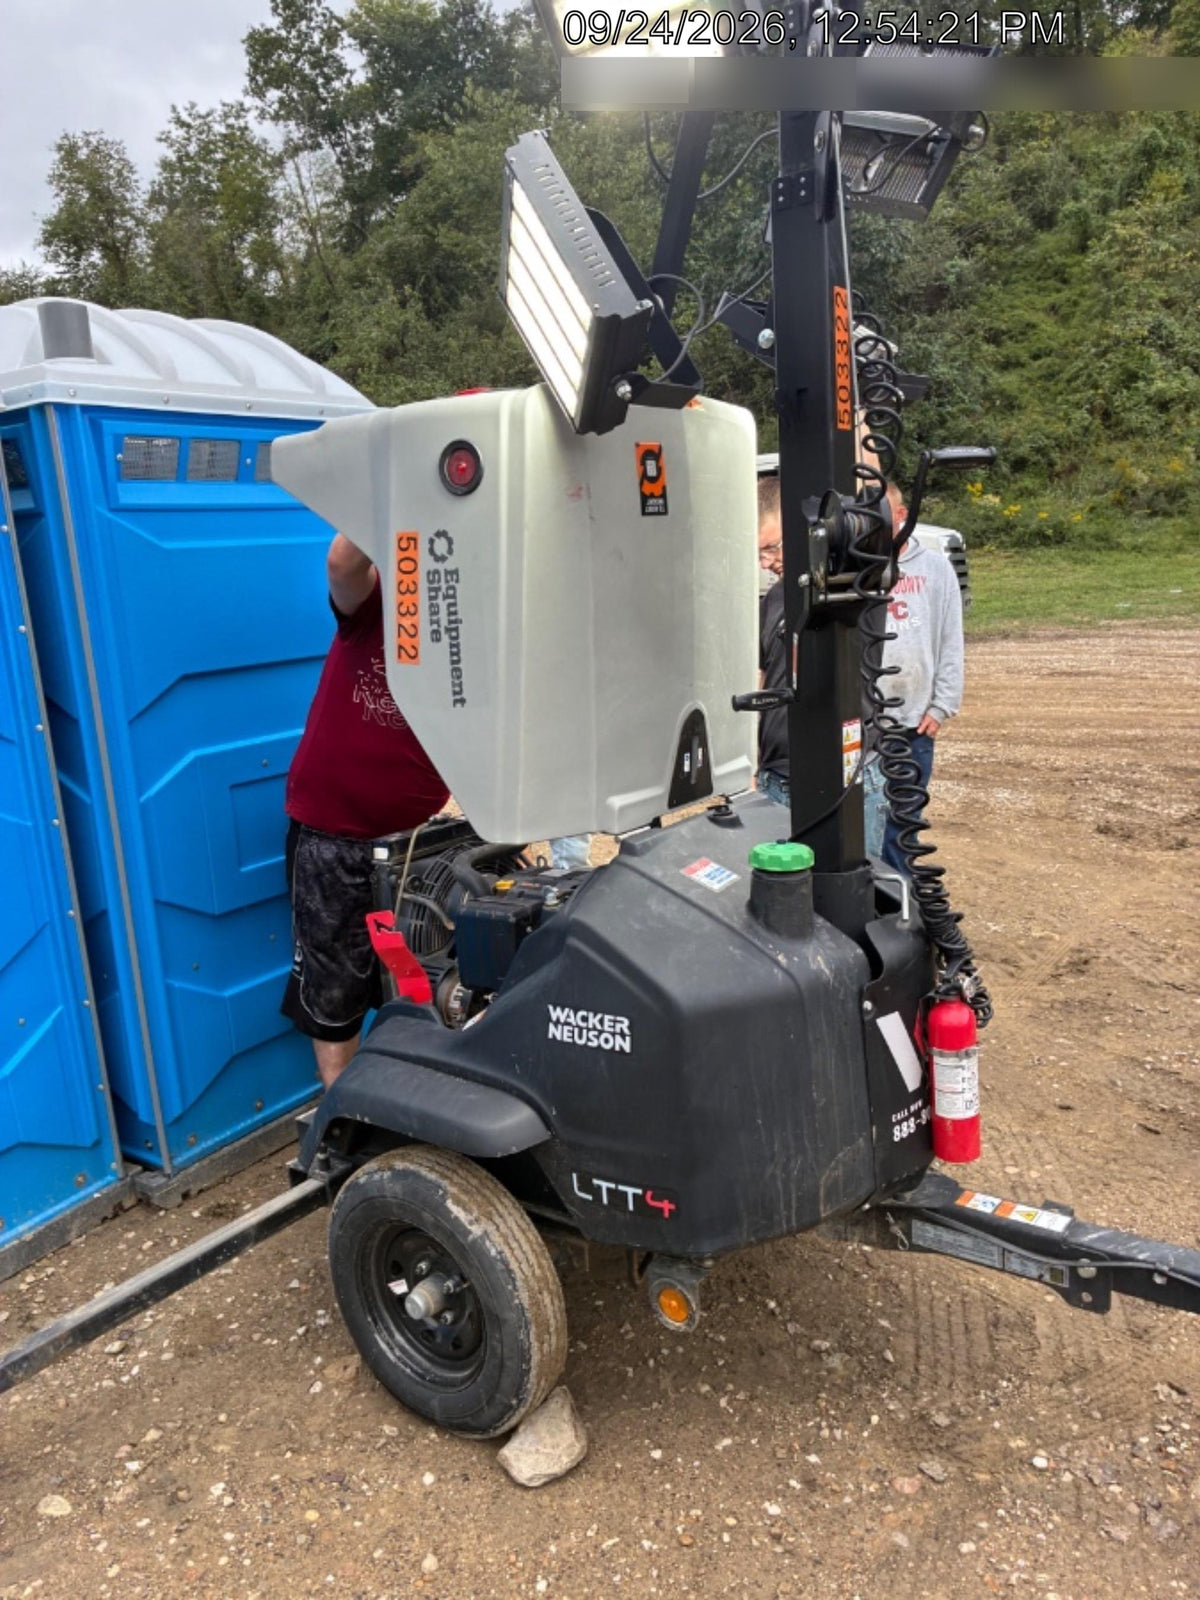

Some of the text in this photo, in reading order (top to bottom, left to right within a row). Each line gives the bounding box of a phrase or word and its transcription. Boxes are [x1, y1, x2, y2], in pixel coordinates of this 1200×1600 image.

[836, 292, 850, 425] 503322
[397, 536, 419, 661] 503322
[426, 568, 442, 644] Share
[442, 568, 467, 708] Equipment
[547, 1004, 632, 1035] WACKER
[548, 1022, 632, 1053] NEUSON
[892, 1108, 909, 1122] CALL
[572, 1172, 676, 1219] LTT4
